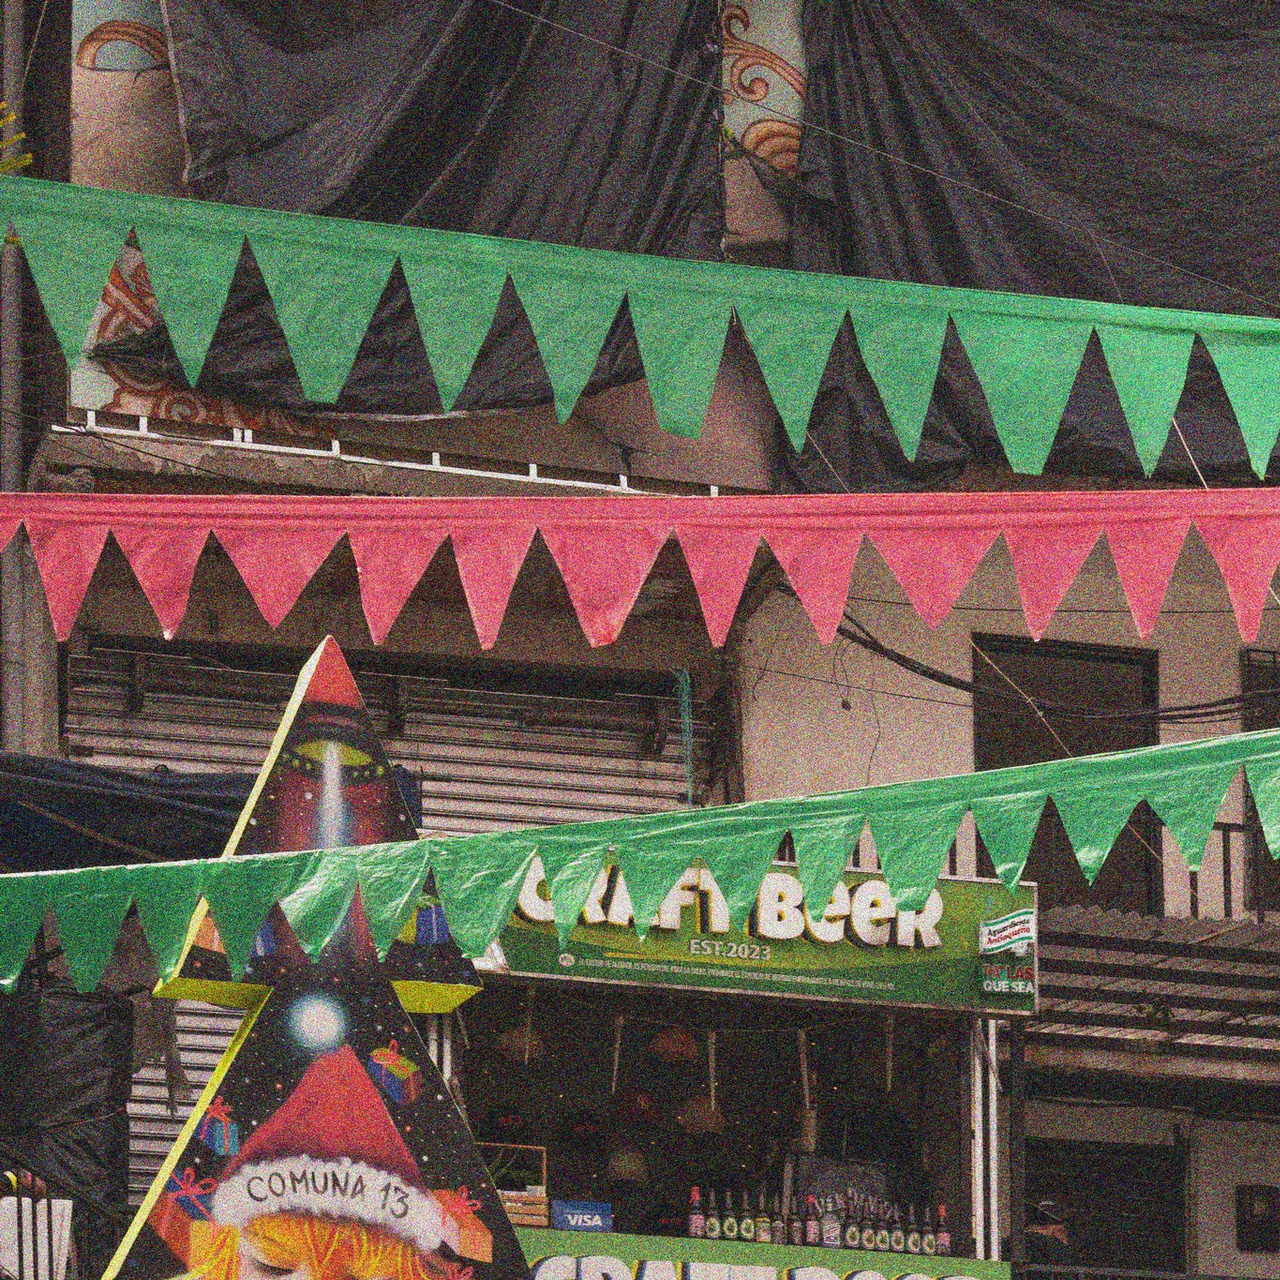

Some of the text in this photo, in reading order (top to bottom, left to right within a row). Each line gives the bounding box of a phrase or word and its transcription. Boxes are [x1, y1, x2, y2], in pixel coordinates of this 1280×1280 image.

[688, 938, 771, 962] EST.2023
[247, 1169, 410, 1219] COMUNA 13
[568, 1213, 603, 1227] VISA
